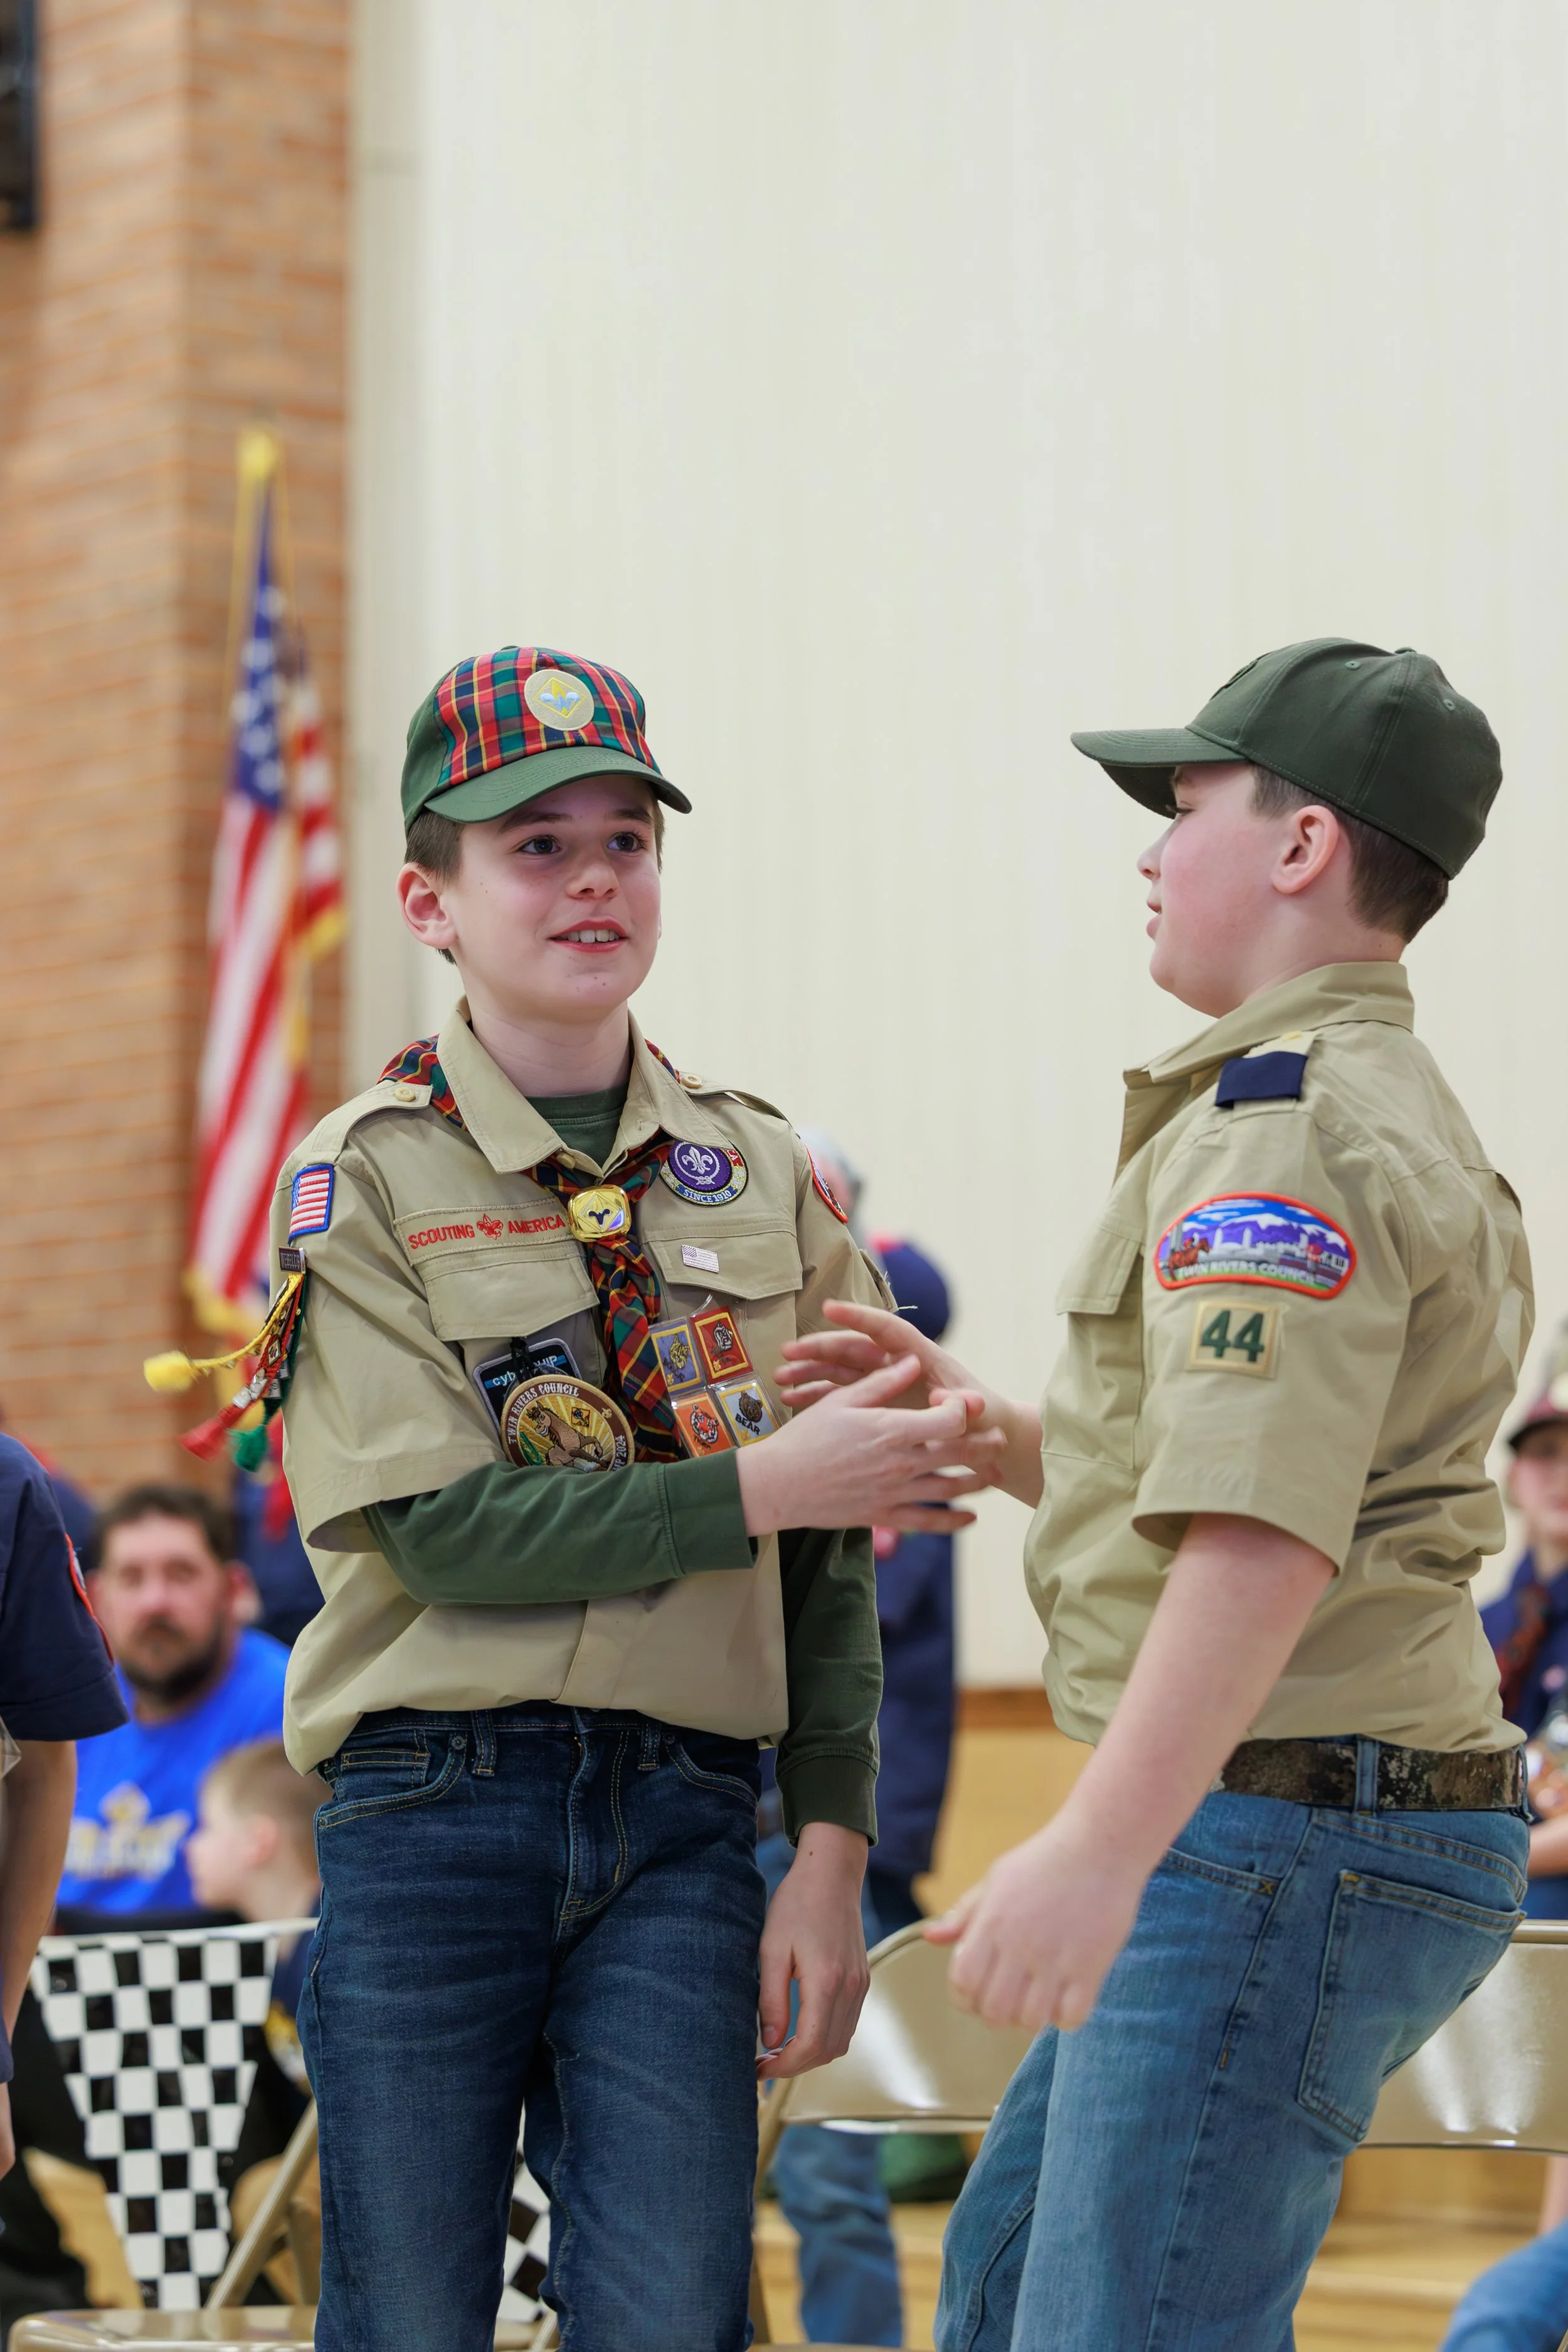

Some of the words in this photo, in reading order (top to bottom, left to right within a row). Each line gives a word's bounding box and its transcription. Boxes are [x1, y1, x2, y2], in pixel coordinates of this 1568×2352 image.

[684, 1189, 713, 1202] SINCE
[713, 1190, 732, 1202] 1910
[408, 1224, 475, 1249] SCOUTING
[508, 1214, 566, 1234] AMERICA
[1200, 1310, 1264, 1362] 44
[511, 1387, 538, 1416] RIVERS
[538, 1382, 580, 1397] COUNCIL
[507, 1417, 518, 1444] TWIN
[735, 1413, 761, 1436] BEAR
[615, 1435, 627, 1457] 2024
